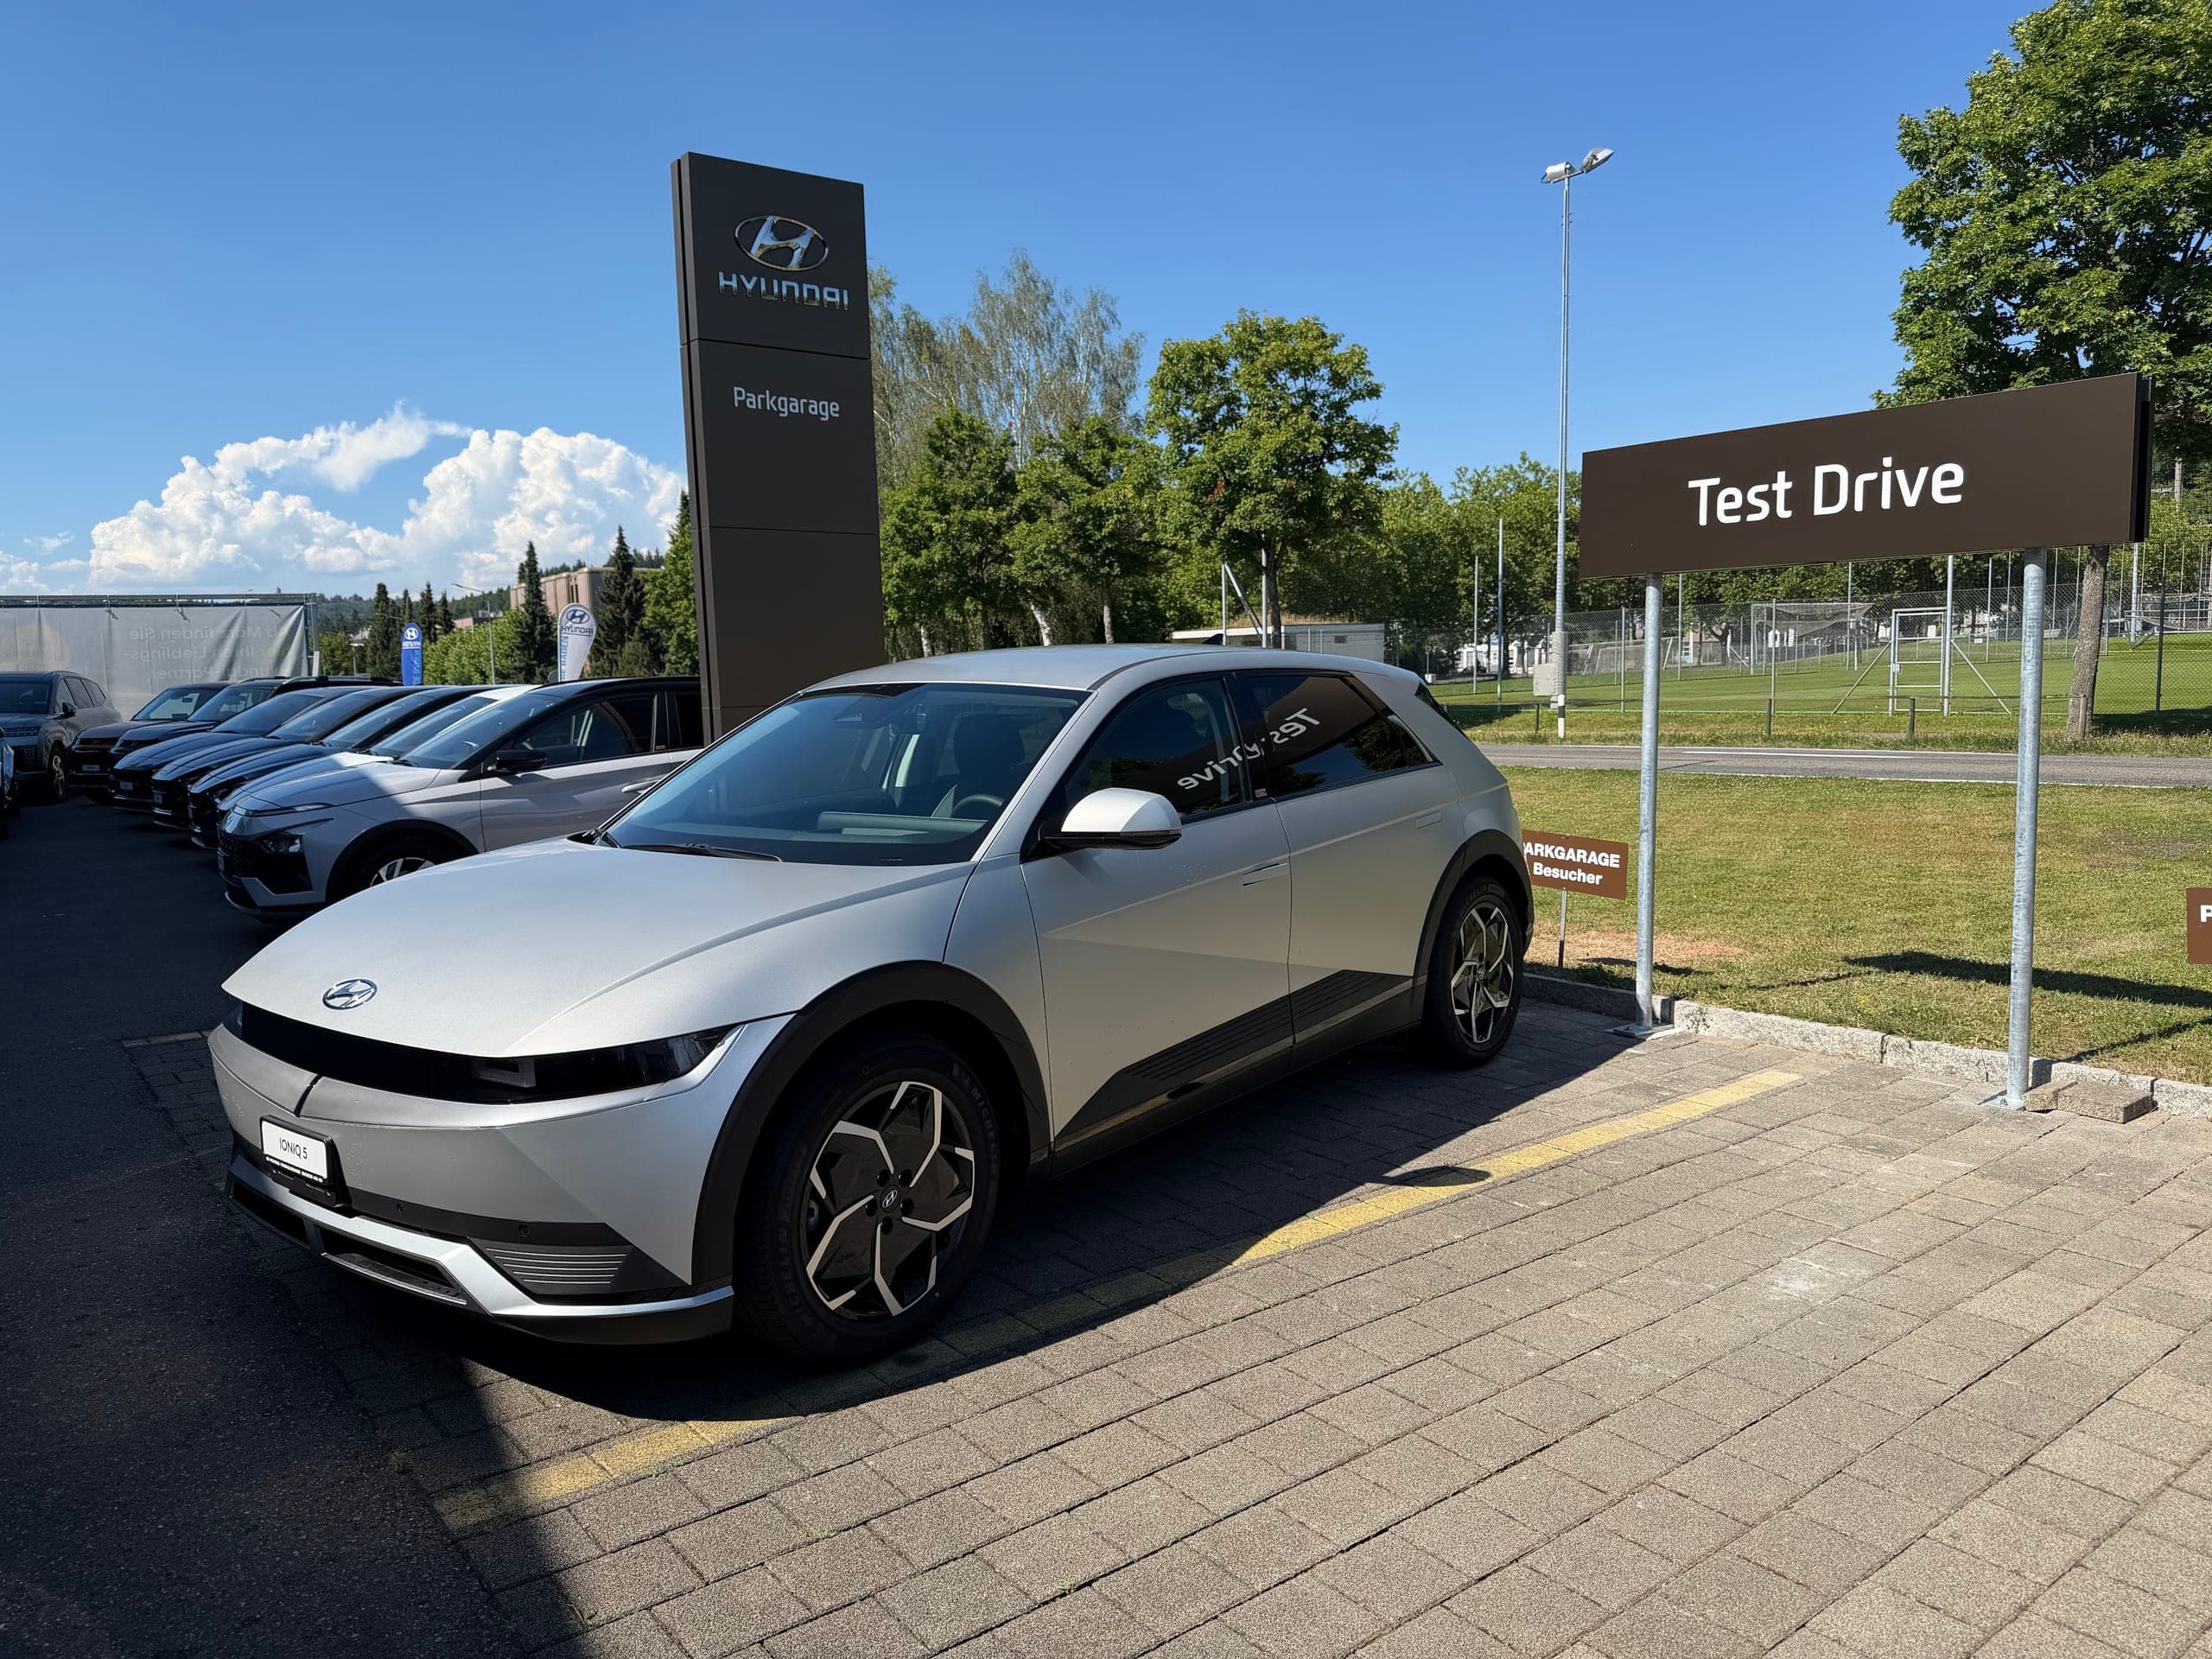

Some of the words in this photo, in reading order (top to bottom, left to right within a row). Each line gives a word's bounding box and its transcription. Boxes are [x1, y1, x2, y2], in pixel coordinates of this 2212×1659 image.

[718, 271, 849, 310] HYUNDAI
[734, 386, 840, 421] Parkgarage
[1688, 471, 1793, 525] Test
[1814, 456, 1964, 516] Drive
[1523, 842, 1621, 868] ARKGARAGE
[1533, 861, 1603, 885] Besucher
[279, 1137, 302, 1160] IONIQ
[302, 1147, 308, 1159] 5
